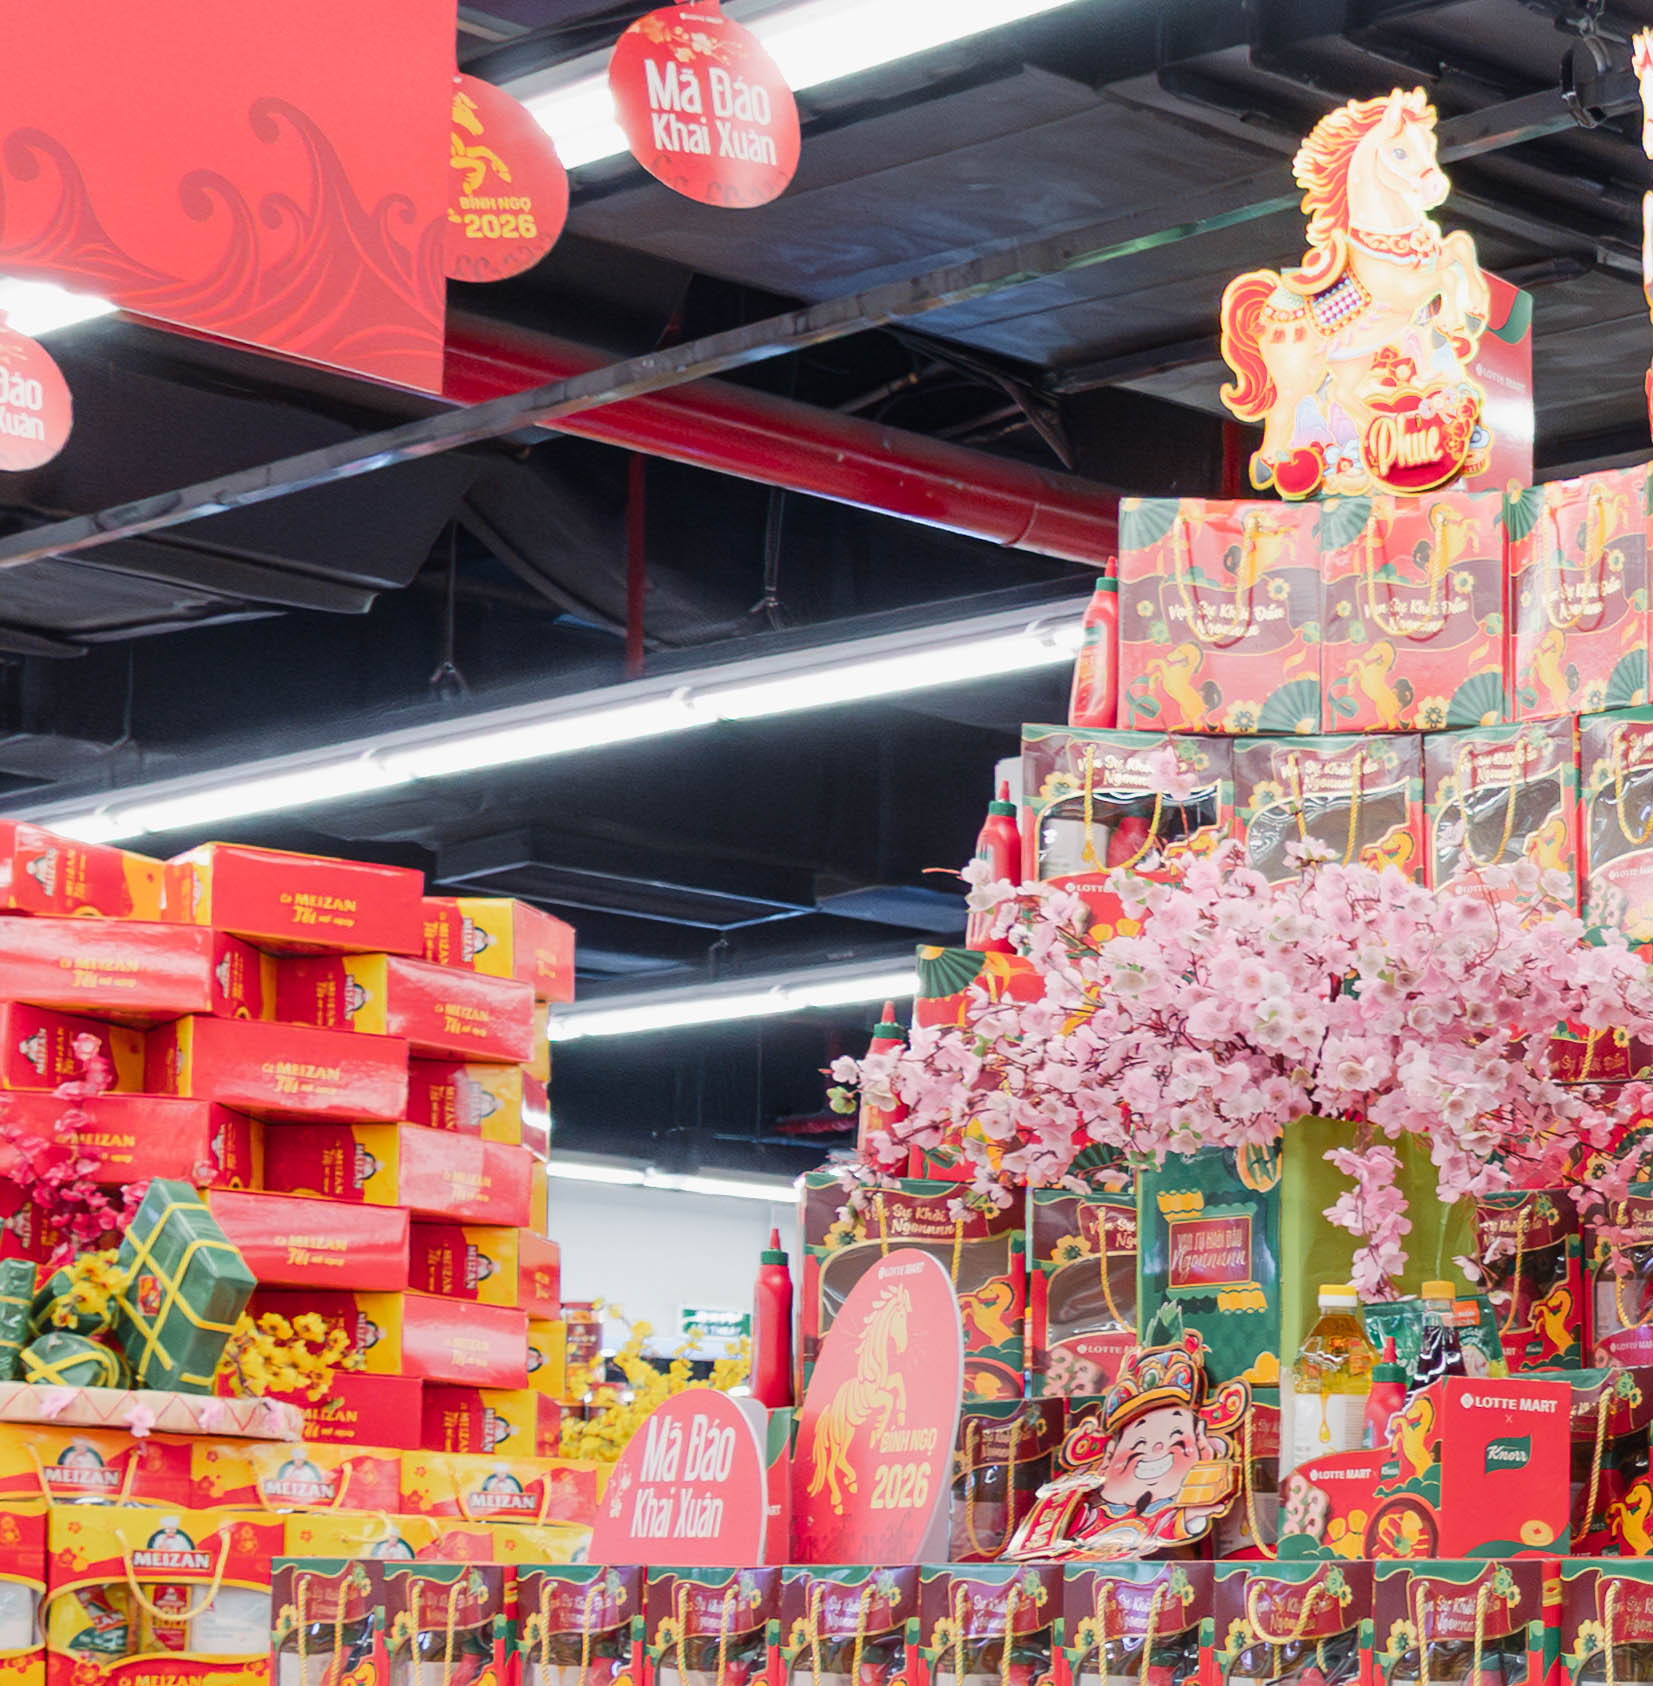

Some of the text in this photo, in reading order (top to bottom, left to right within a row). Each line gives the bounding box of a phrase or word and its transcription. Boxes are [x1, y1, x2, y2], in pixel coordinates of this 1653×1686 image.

[645, 60, 773, 125] Mã Đáo
[652, 113, 776, 165] Khai Xuân
[464, 215, 536, 238] 2026
[1473, 1395, 1557, 1412] LOTTE MART
[641, 1414, 735, 1482] Mã Đáo
[1488, 1445, 1528, 1461] Knorr
[45, 1466, 119, 1487] MEIZAN
[871, 1463, 931, 1508] 2026
[265, 1480, 335, 1499] MEIZAN
[631, 1488, 723, 1537] Khai Xuân
[134, 1553, 209, 1567] MEIZAN
